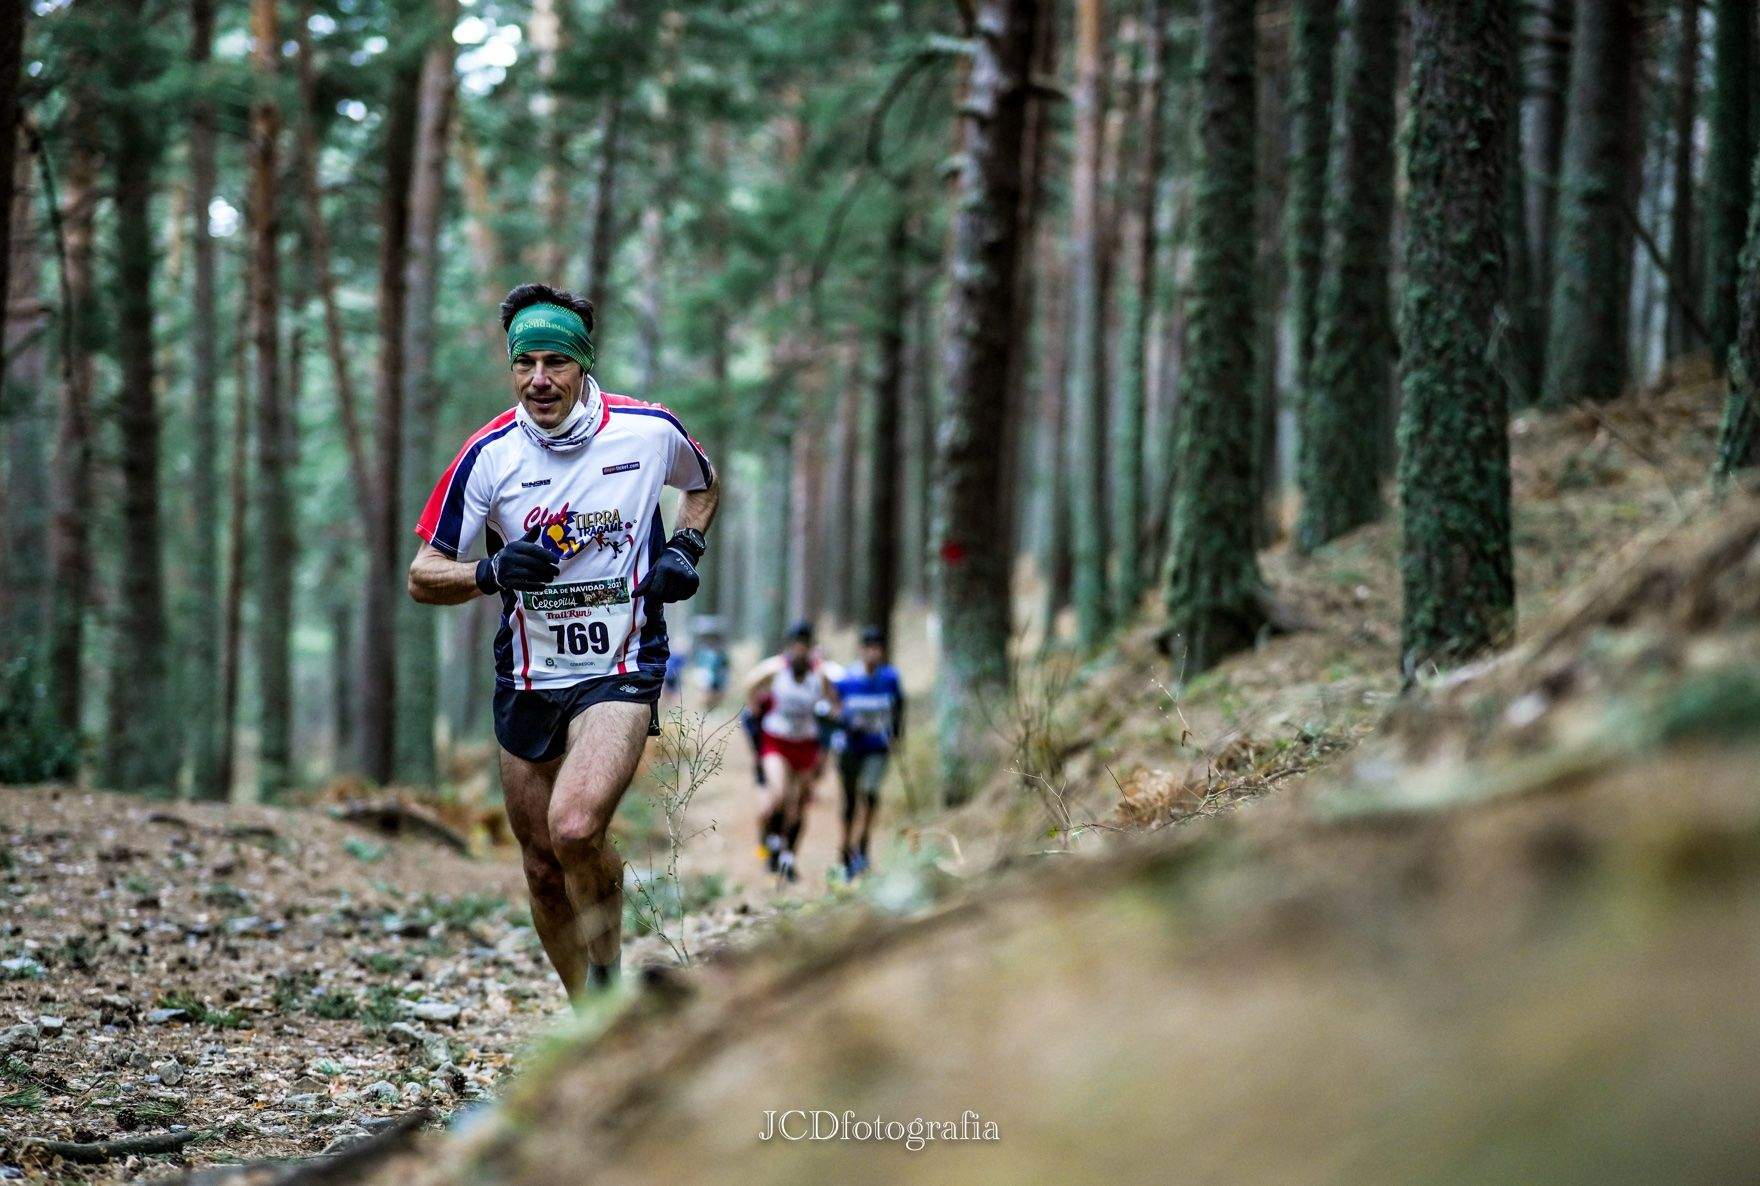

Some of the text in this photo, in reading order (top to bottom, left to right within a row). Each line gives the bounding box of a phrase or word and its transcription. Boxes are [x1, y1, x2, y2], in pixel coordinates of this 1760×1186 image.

[523, 502, 570, 532] Club
[574, 508, 621, 531] TIERRA
[570, 584, 604, 593] NAVIDAD
[548, 621, 610, 656] 769
